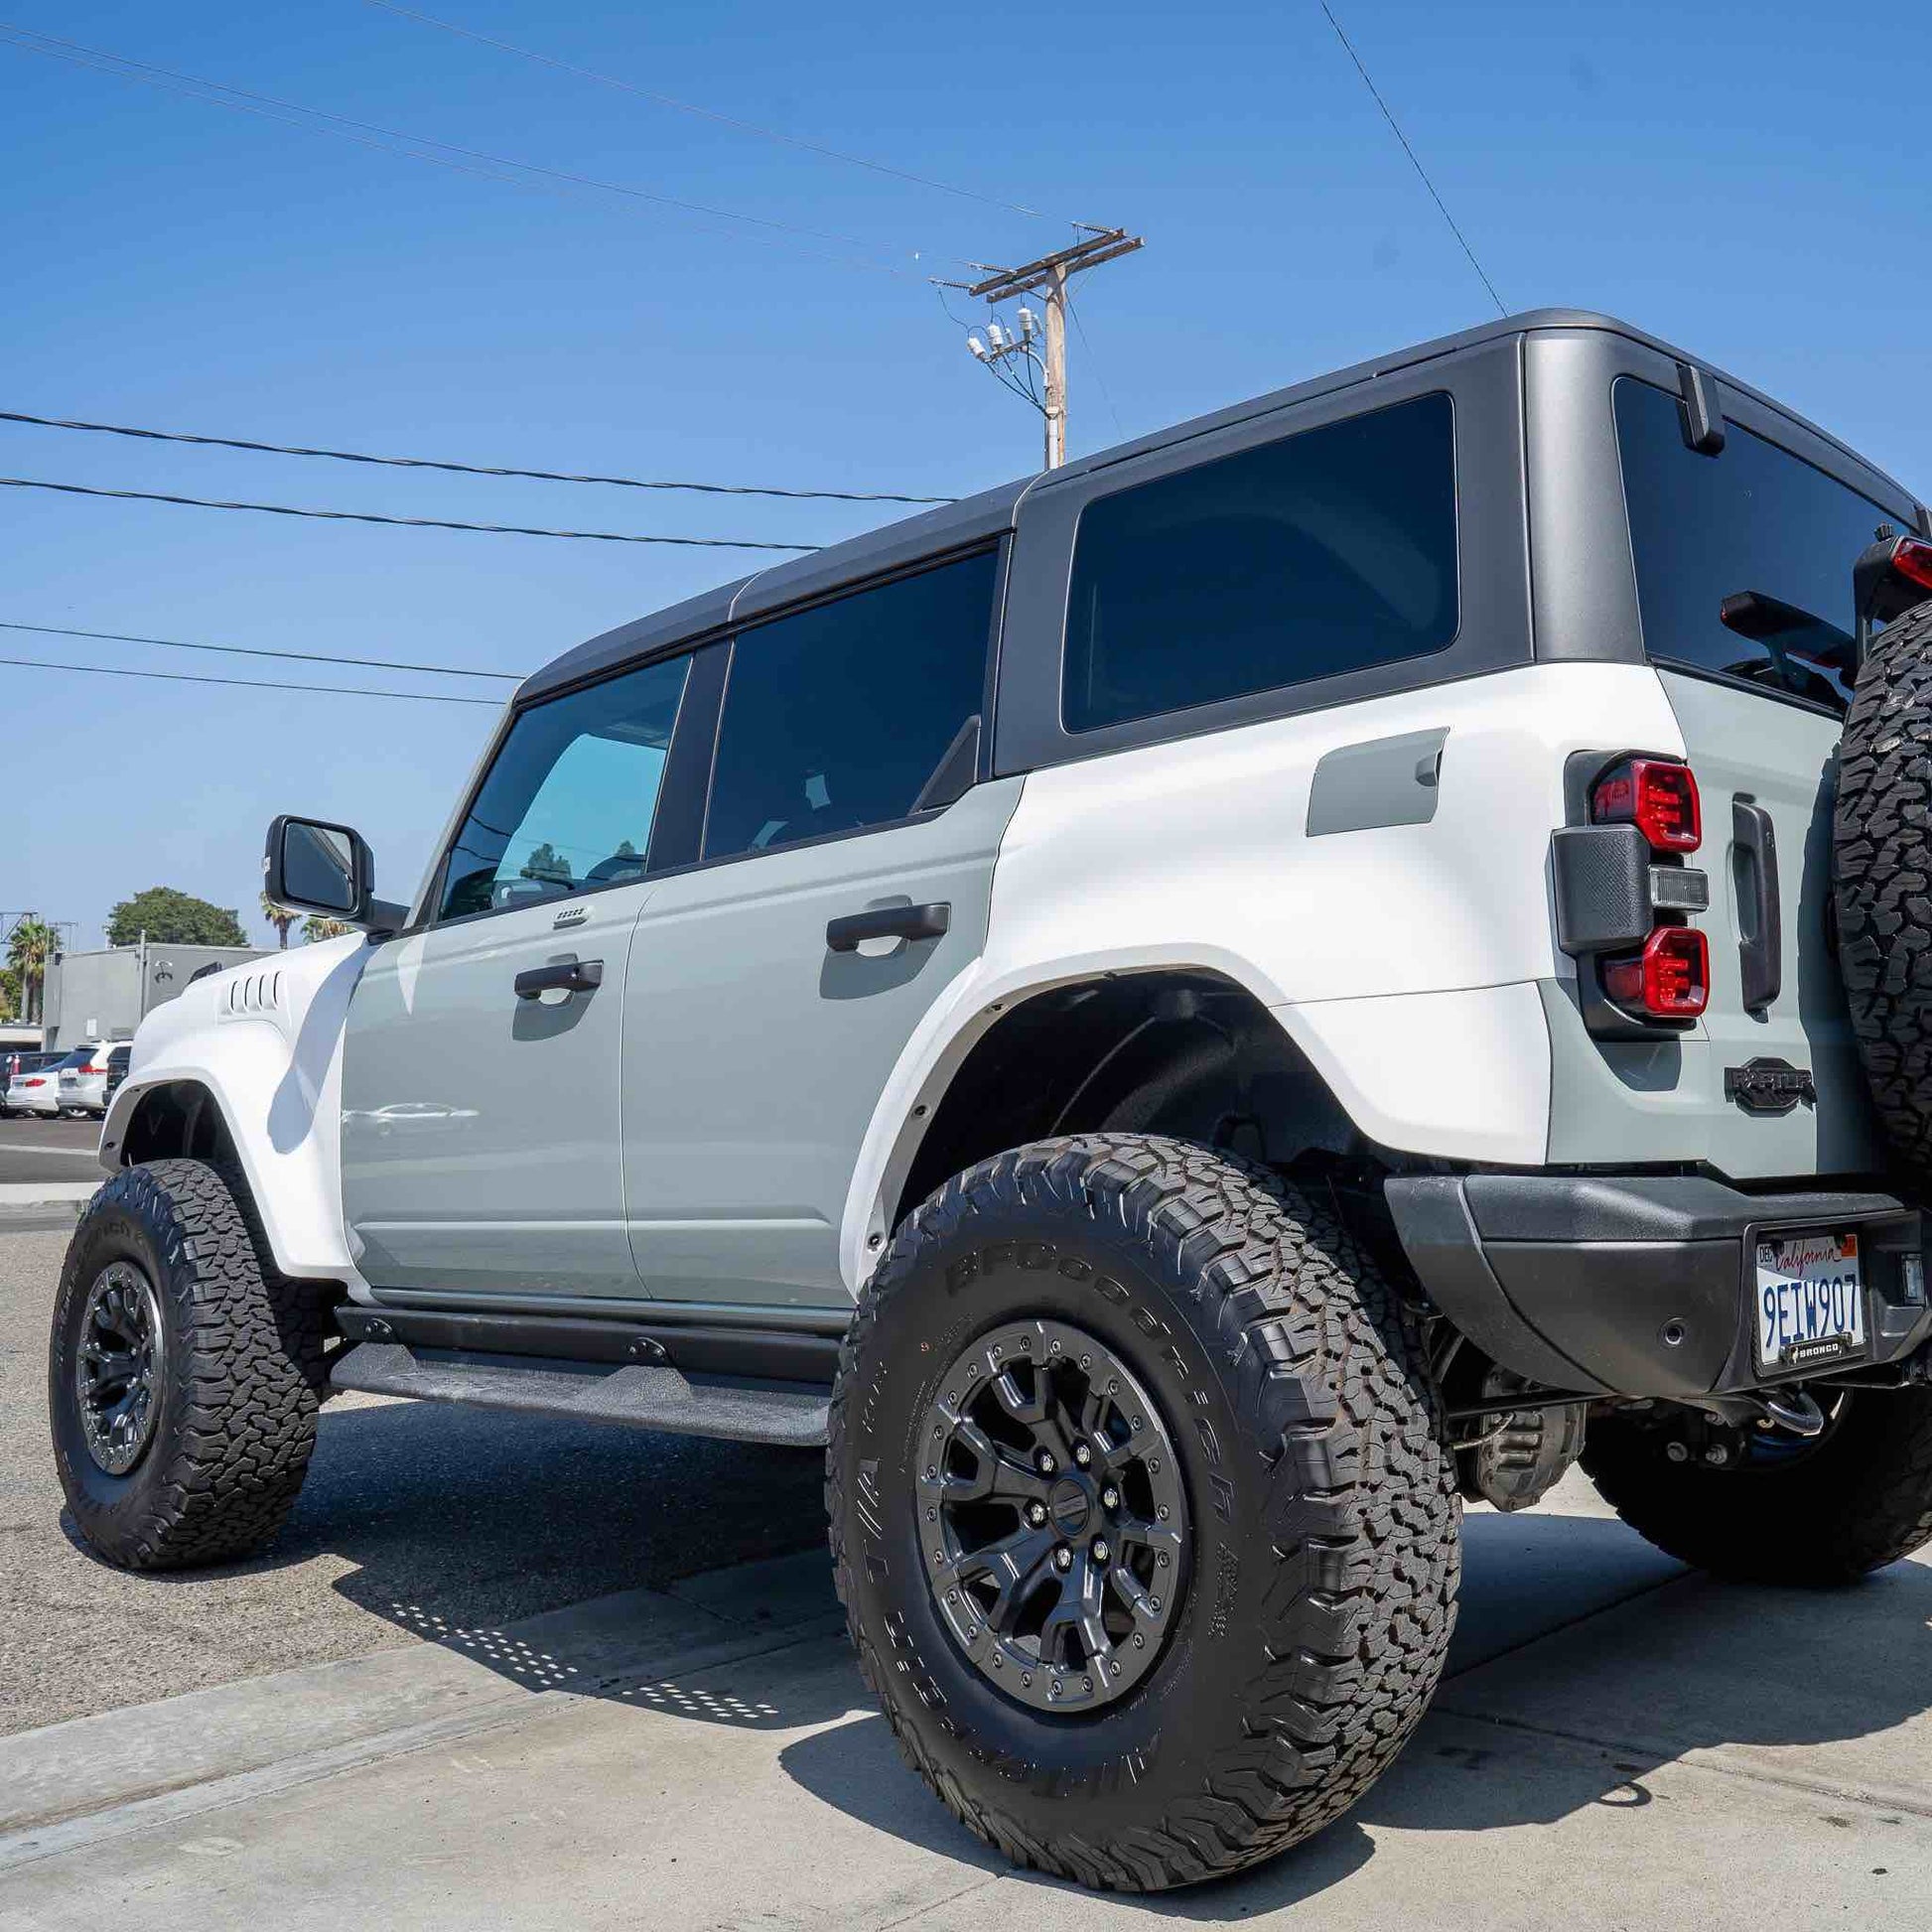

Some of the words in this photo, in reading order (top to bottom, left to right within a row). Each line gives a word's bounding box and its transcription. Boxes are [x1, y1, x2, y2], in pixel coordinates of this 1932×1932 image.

[1775, 1241, 1843, 1277] California
[1763, 1273, 1857, 1348] 9EIW907
[1799, 1342, 1839, 1358] BRONCO
